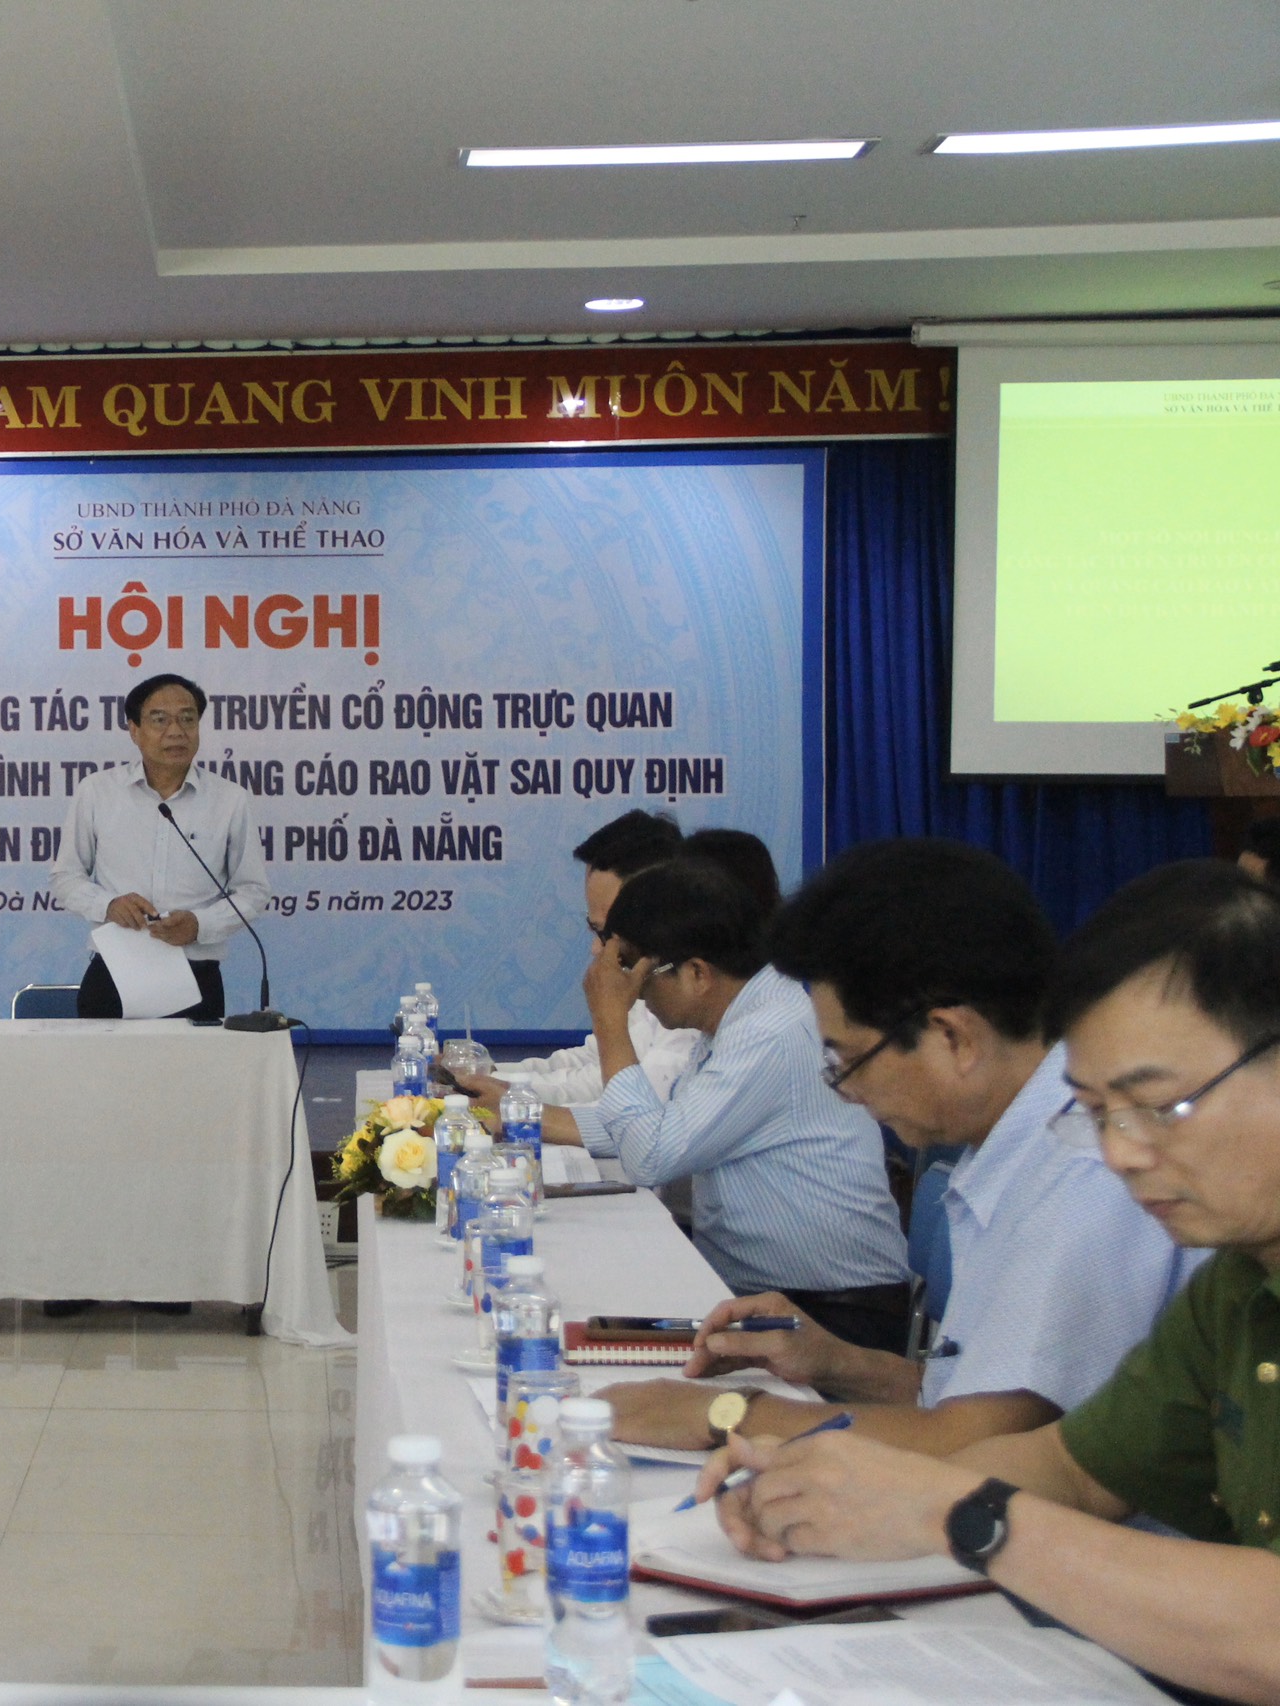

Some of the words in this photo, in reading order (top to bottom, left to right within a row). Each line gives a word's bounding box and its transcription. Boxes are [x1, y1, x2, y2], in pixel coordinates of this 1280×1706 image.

[103, 380, 337, 437] QUANG
[361, 376, 526, 422] VINH
[547, 363, 748, 419] MUÔN
[768, 358, 921, 413] NĂM
[77, 502, 135, 518] UBND
[140, 498, 213, 518] THÀNH
[266, 496, 295, 516] ĐÀ
[54, 524, 84, 551] SỞ
[91, 527, 144, 551] VĂN
[154, 526, 206, 550] HÓA
[216, 524, 249, 549] VÀ
[257, 520, 308, 549] THỂ
[315, 529, 385, 549] THAO
[58, 581, 184, 668] HỘI
[204, 593, 380, 667] NGHỊ
[30, 688, 89, 731] TÁC
[209, 683, 331, 730] TRUYỀN
[341, 679, 385, 730] CỔ
[393, 686, 482, 738] ĐỘNG
[493, 688, 575, 737] TRỰC
[585, 692, 673, 733] QUAN
[197, 748, 284, 796] ẢNG
[295, 752, 358, 796] CÁO
[369, 760, 430, 796] RAO
[442, 751, 500, 803] VẶT
[510, 759, 561, 795] SAI
[573, 758, 635, 797] QUY
[645, 758, 724, 803] ĐỊNH
[285, 812, 349, 862] PHỐ
[358, 818, 402, 862] ĐÀ
[412, 811, 503, 862] NẴNG
[305, 890, 321, 911] 5
[327, 890, 384, 911] năm
[391, 889, 454, 911] 2023
